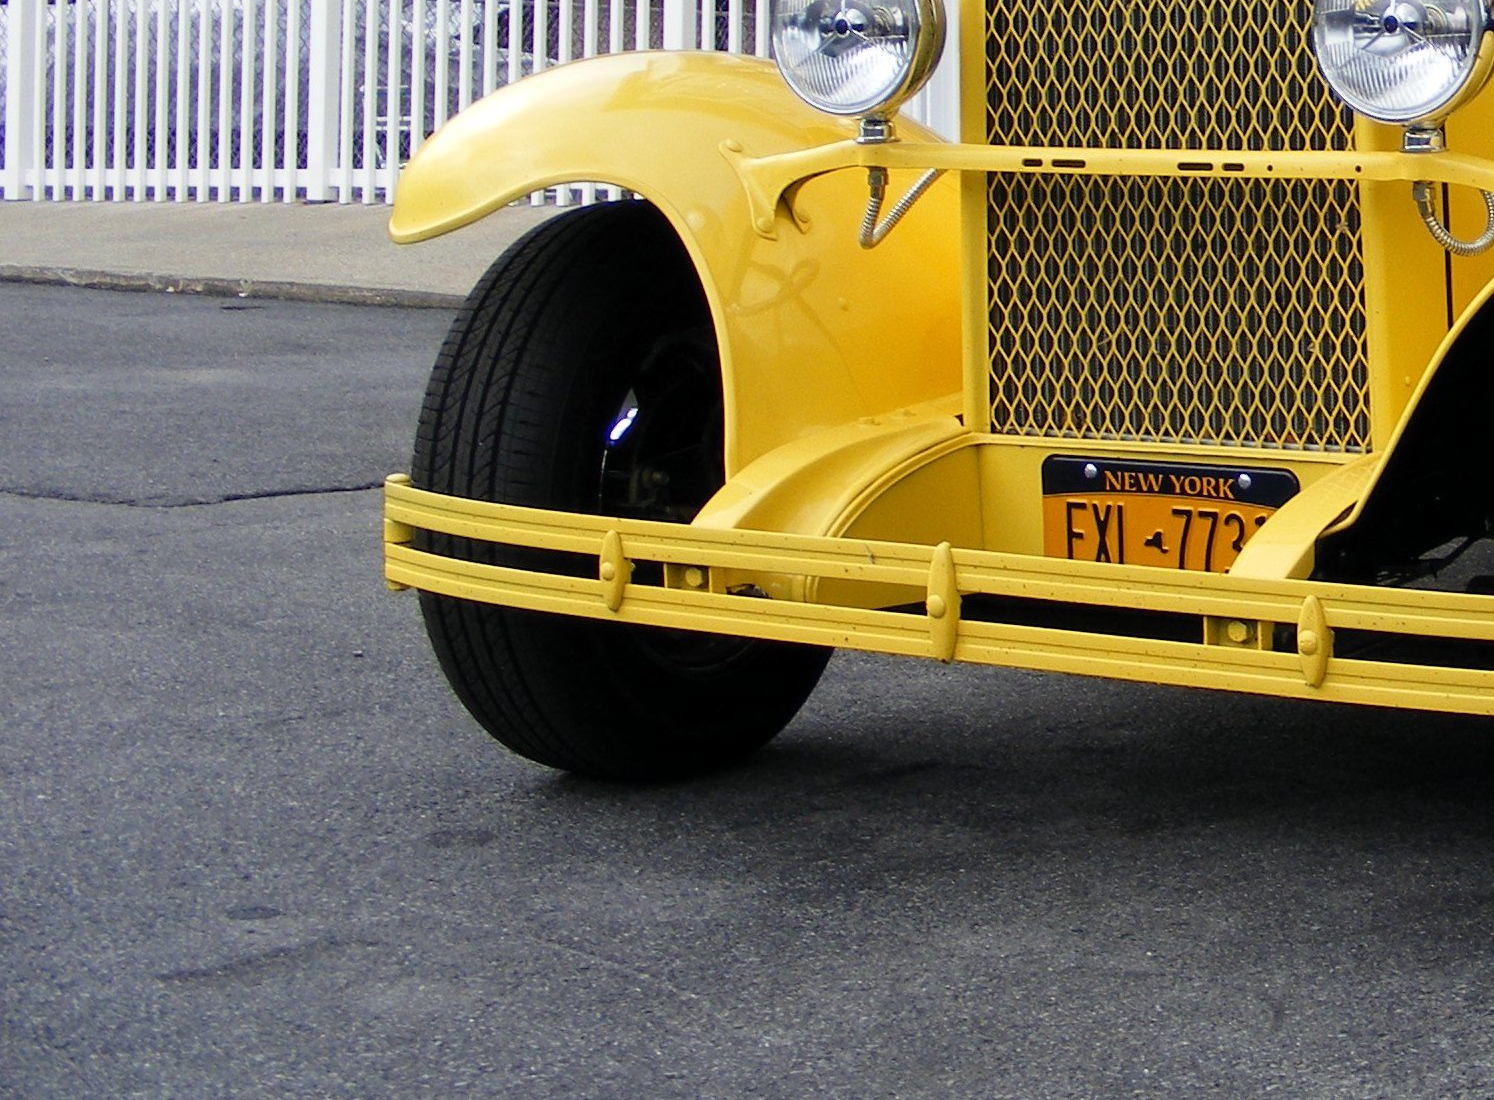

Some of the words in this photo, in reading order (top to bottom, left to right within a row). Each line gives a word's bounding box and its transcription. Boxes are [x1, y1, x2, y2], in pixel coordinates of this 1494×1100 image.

[1104, 470, 1163, 493] NEW
[1169, 474, 1235, 499] YORK
[1171, 505, 1268, 574] 773
